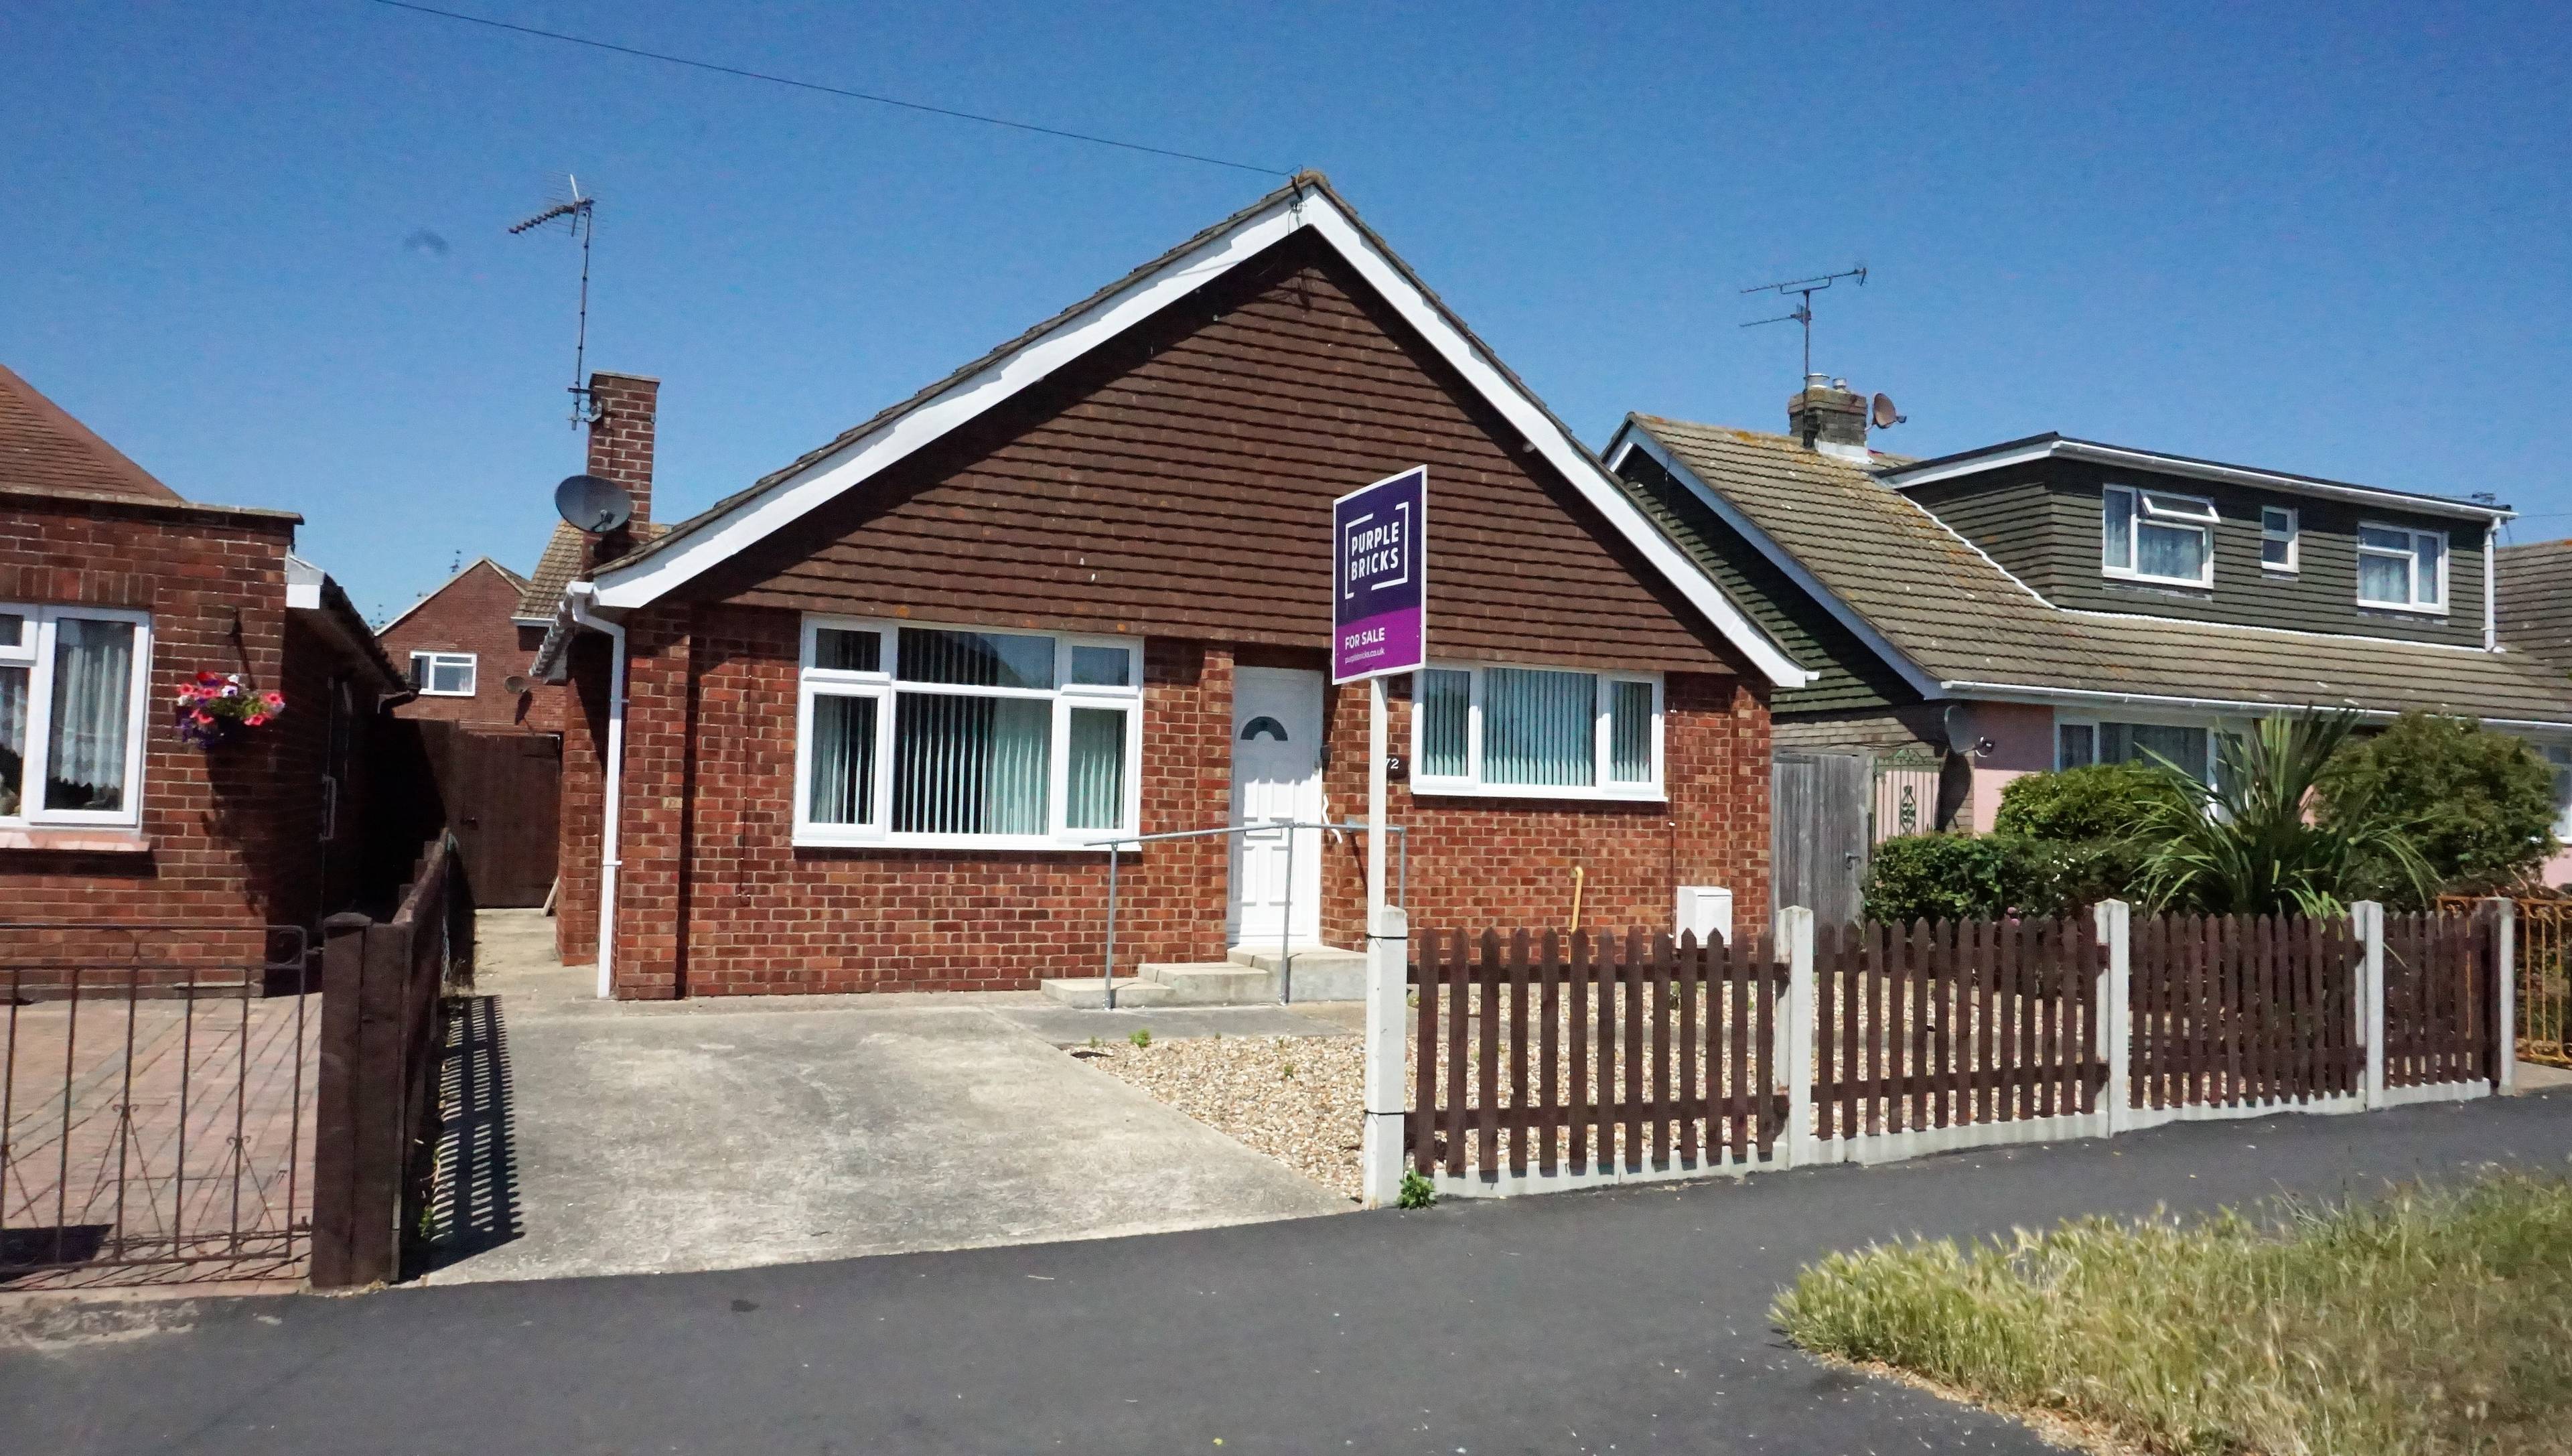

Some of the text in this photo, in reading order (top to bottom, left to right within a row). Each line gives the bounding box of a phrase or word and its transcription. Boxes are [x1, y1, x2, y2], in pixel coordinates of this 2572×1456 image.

[1352, 522, 1399, 556] PURPLE
[1351, 548, 1399, 581] BRICKS
[1345, 627, 1385, 650] FOR SALE
[1345, 647, 1385, 664] pcks.co.uk
